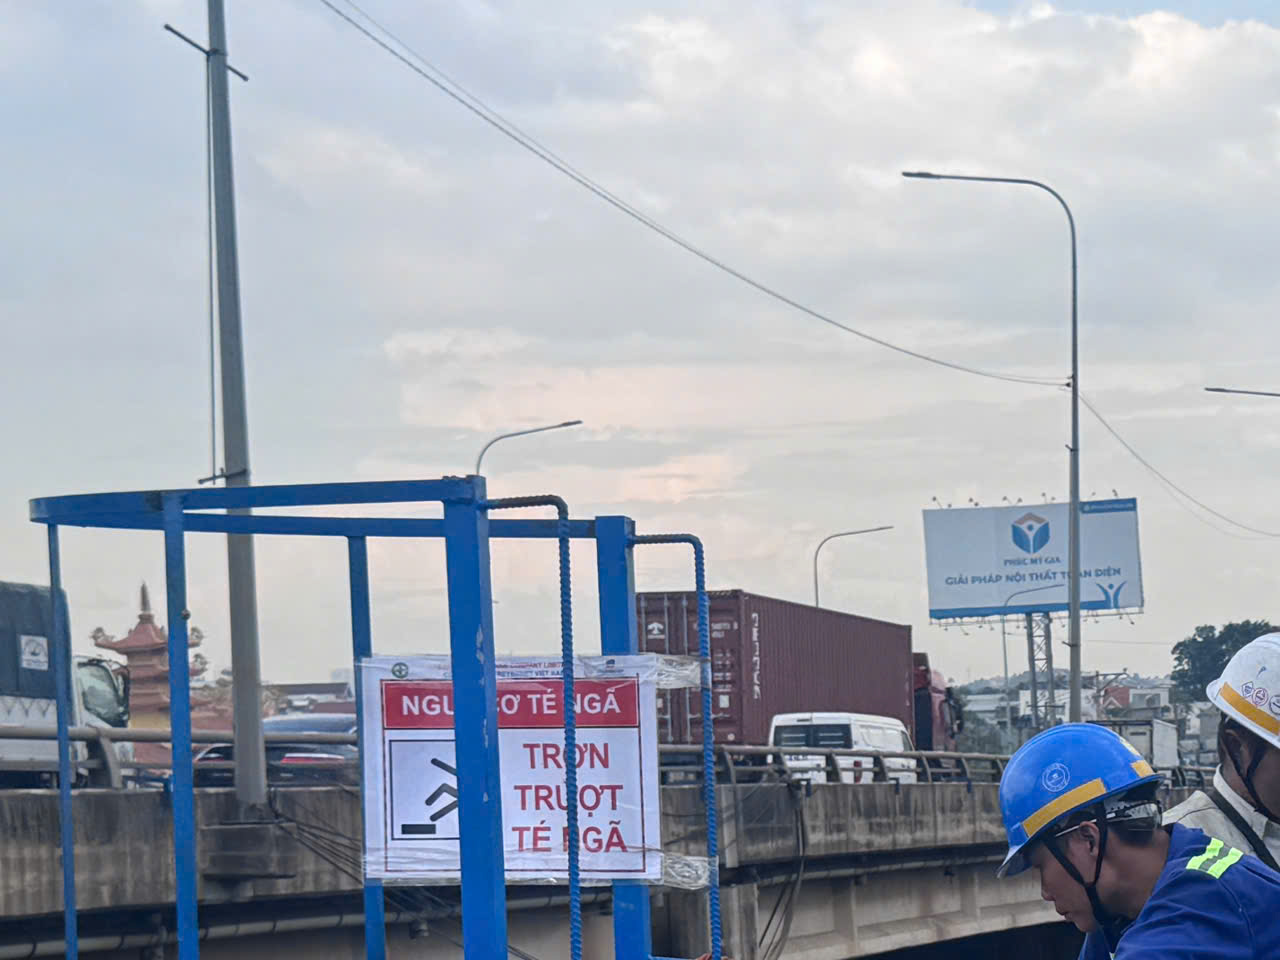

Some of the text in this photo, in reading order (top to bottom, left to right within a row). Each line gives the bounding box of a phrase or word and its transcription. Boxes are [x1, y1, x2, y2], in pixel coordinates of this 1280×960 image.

[402, 695, 454, 716] NGU
[497, 694, 521, 715] Ơ
[527, 689, 557, 715] TÉ
[523, 743, 609, 769] TRƠN
[512, 820, 552, 853] TÉ
